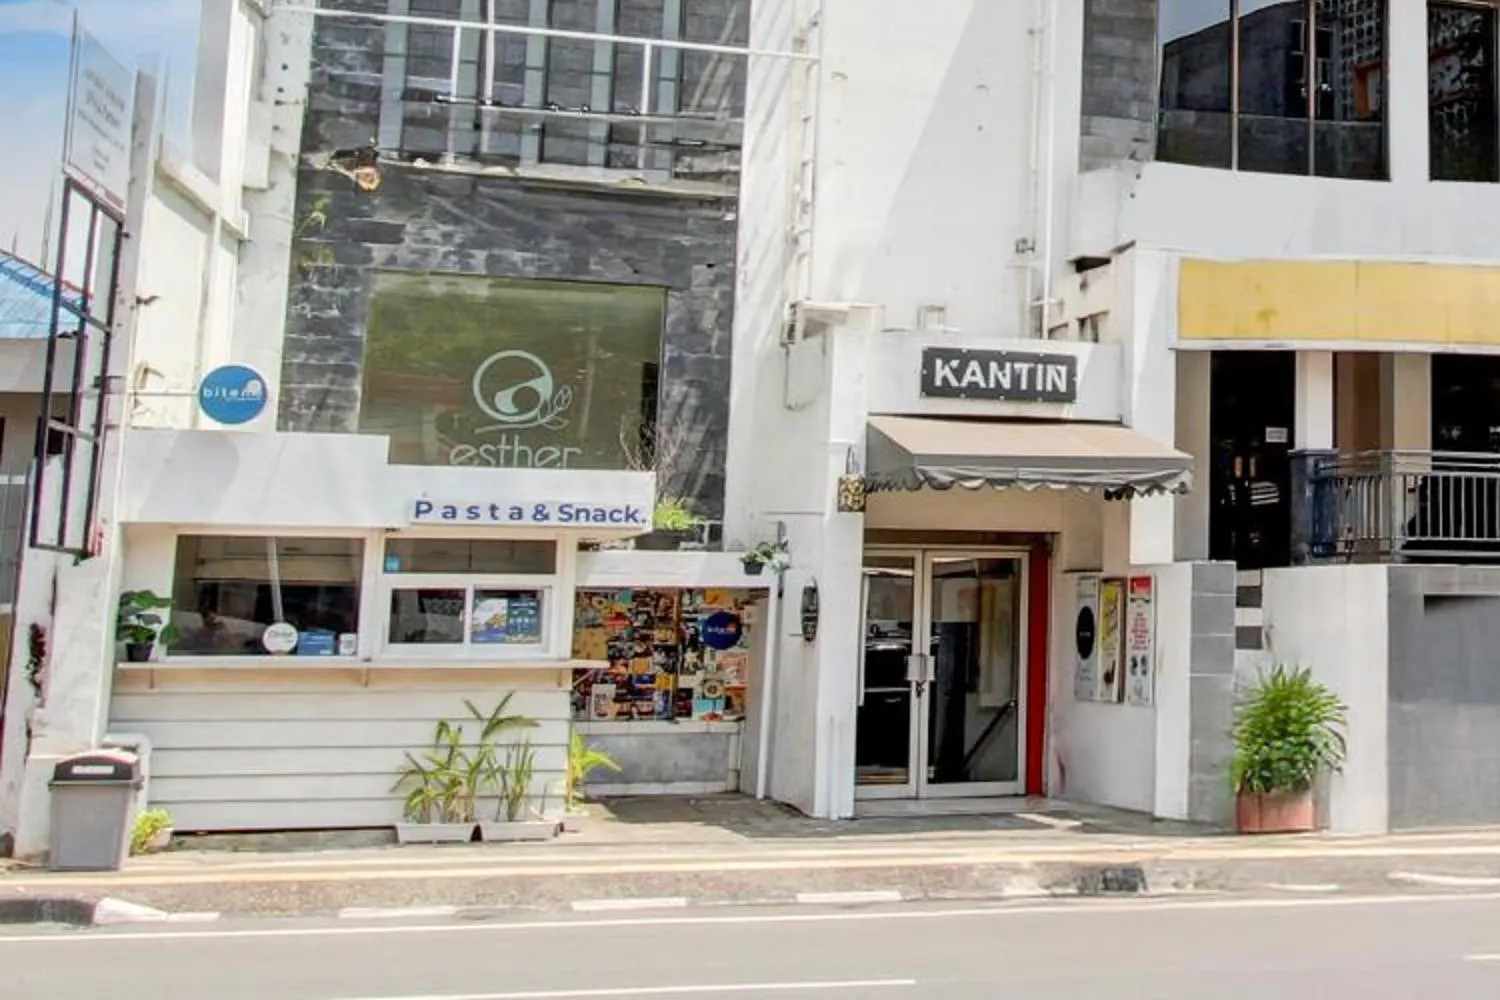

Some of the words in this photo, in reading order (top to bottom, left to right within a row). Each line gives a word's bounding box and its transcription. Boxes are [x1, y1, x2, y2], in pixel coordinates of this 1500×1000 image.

[934, 358, 1067, 393] KANTIN
[449, 433, 583, 467] esther
[415, 500, 524, 521] Pasta
[531, 503, 550, 522] &
[557, 503, 648, 524] Snack.
